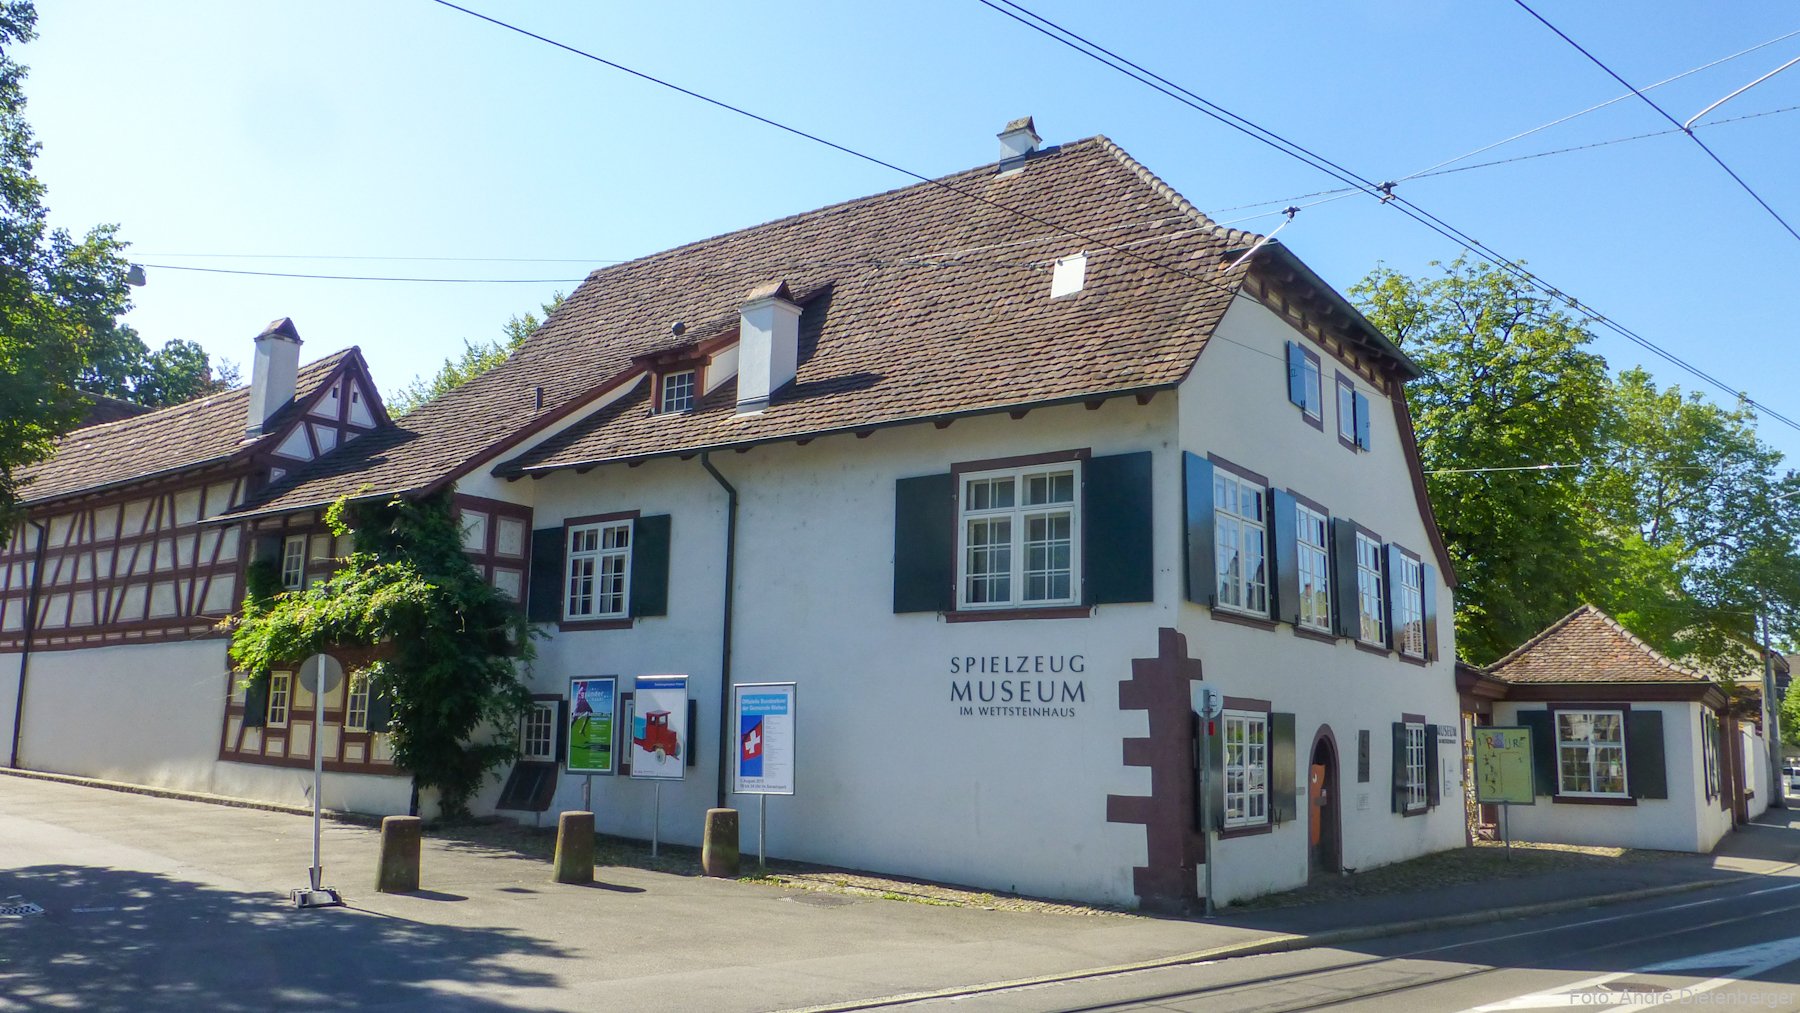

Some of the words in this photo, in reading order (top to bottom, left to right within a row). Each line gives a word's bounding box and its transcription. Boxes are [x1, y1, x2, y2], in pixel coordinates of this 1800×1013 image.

[950, 655, 1085, 674] SPIELZEUG
[950, 680, 1086, 703] MUSEUM
[959, 706, 973, 716] IM
[978, 706, 1076, 718] WETTSTEINHAUS
